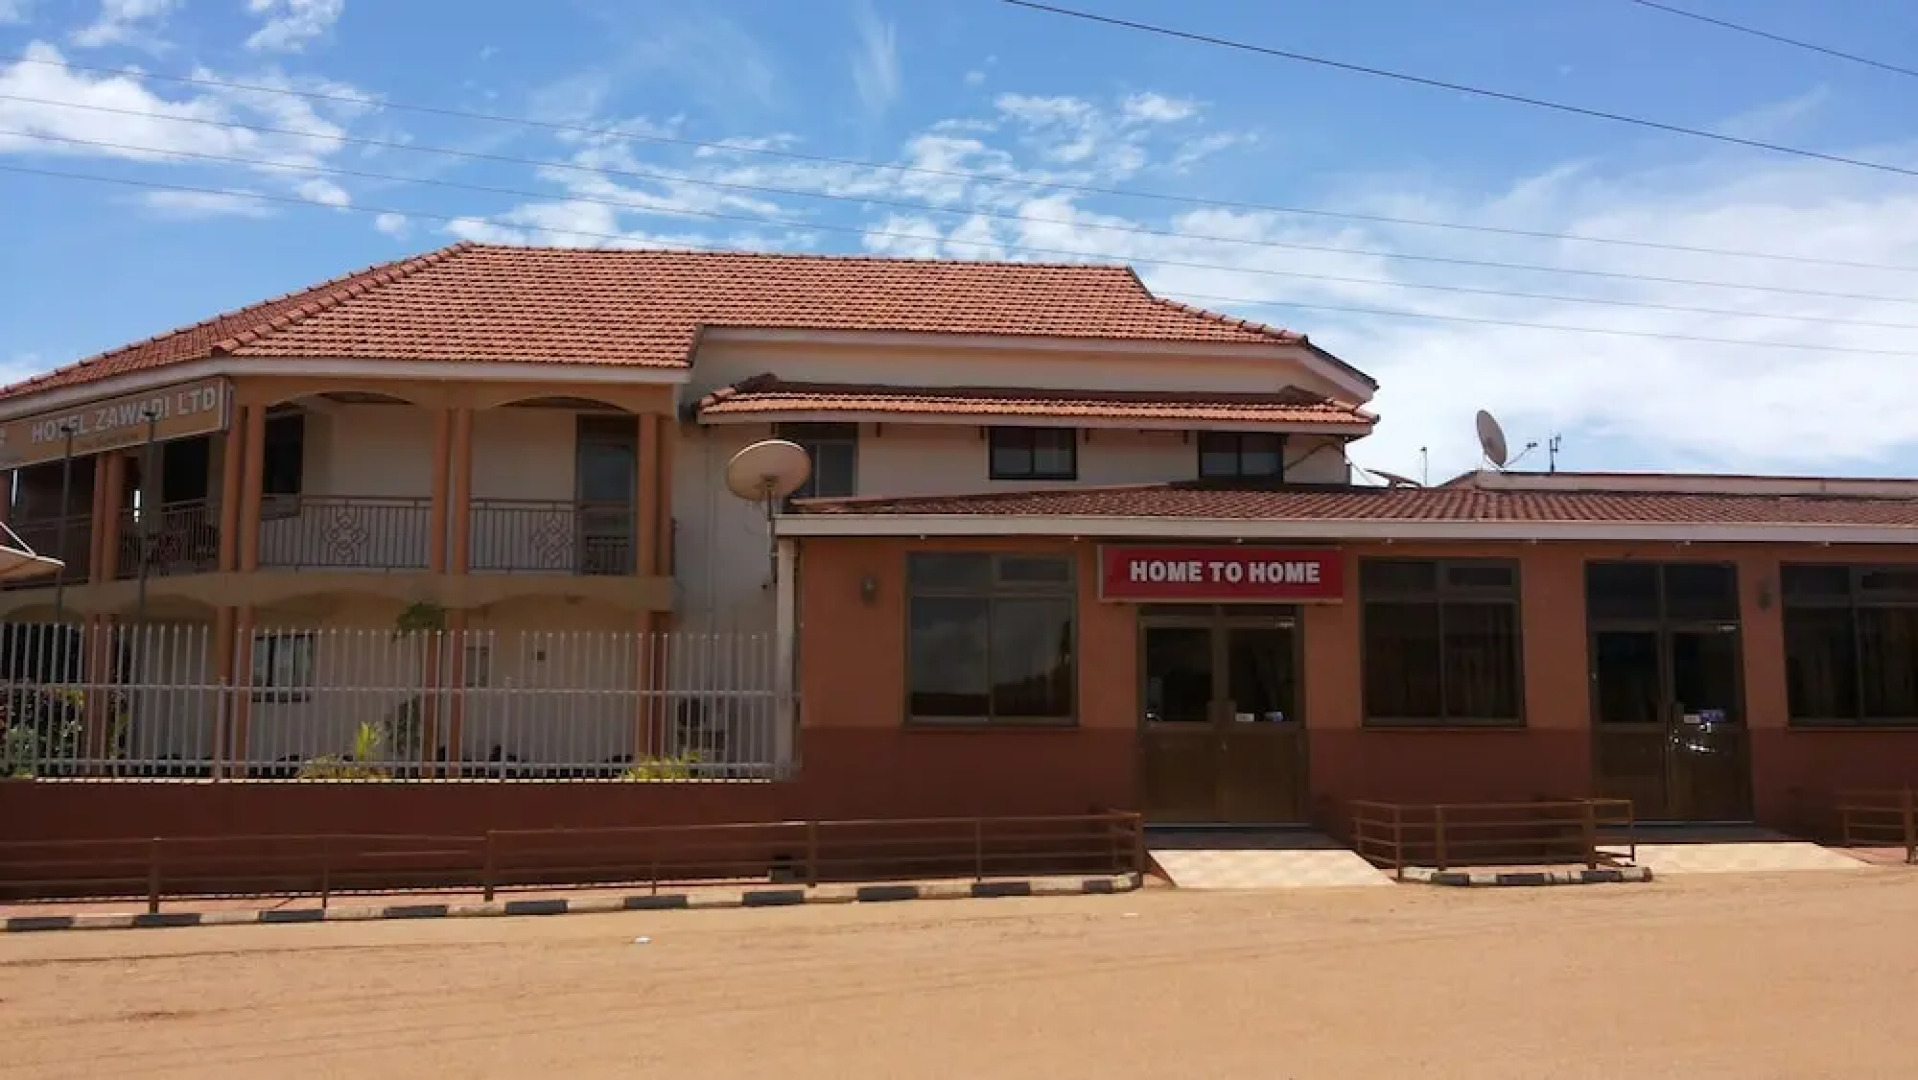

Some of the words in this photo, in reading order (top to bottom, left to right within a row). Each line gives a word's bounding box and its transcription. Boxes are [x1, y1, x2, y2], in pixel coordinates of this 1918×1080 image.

[32, 414, 90, 444] HOTEL
[177, 387, 216, 415] LTD
[1130, 561, 1203, 582] HOME
[1208, 562, 1243, 583] TO
[1249, 562, 1321, 583] HOME
